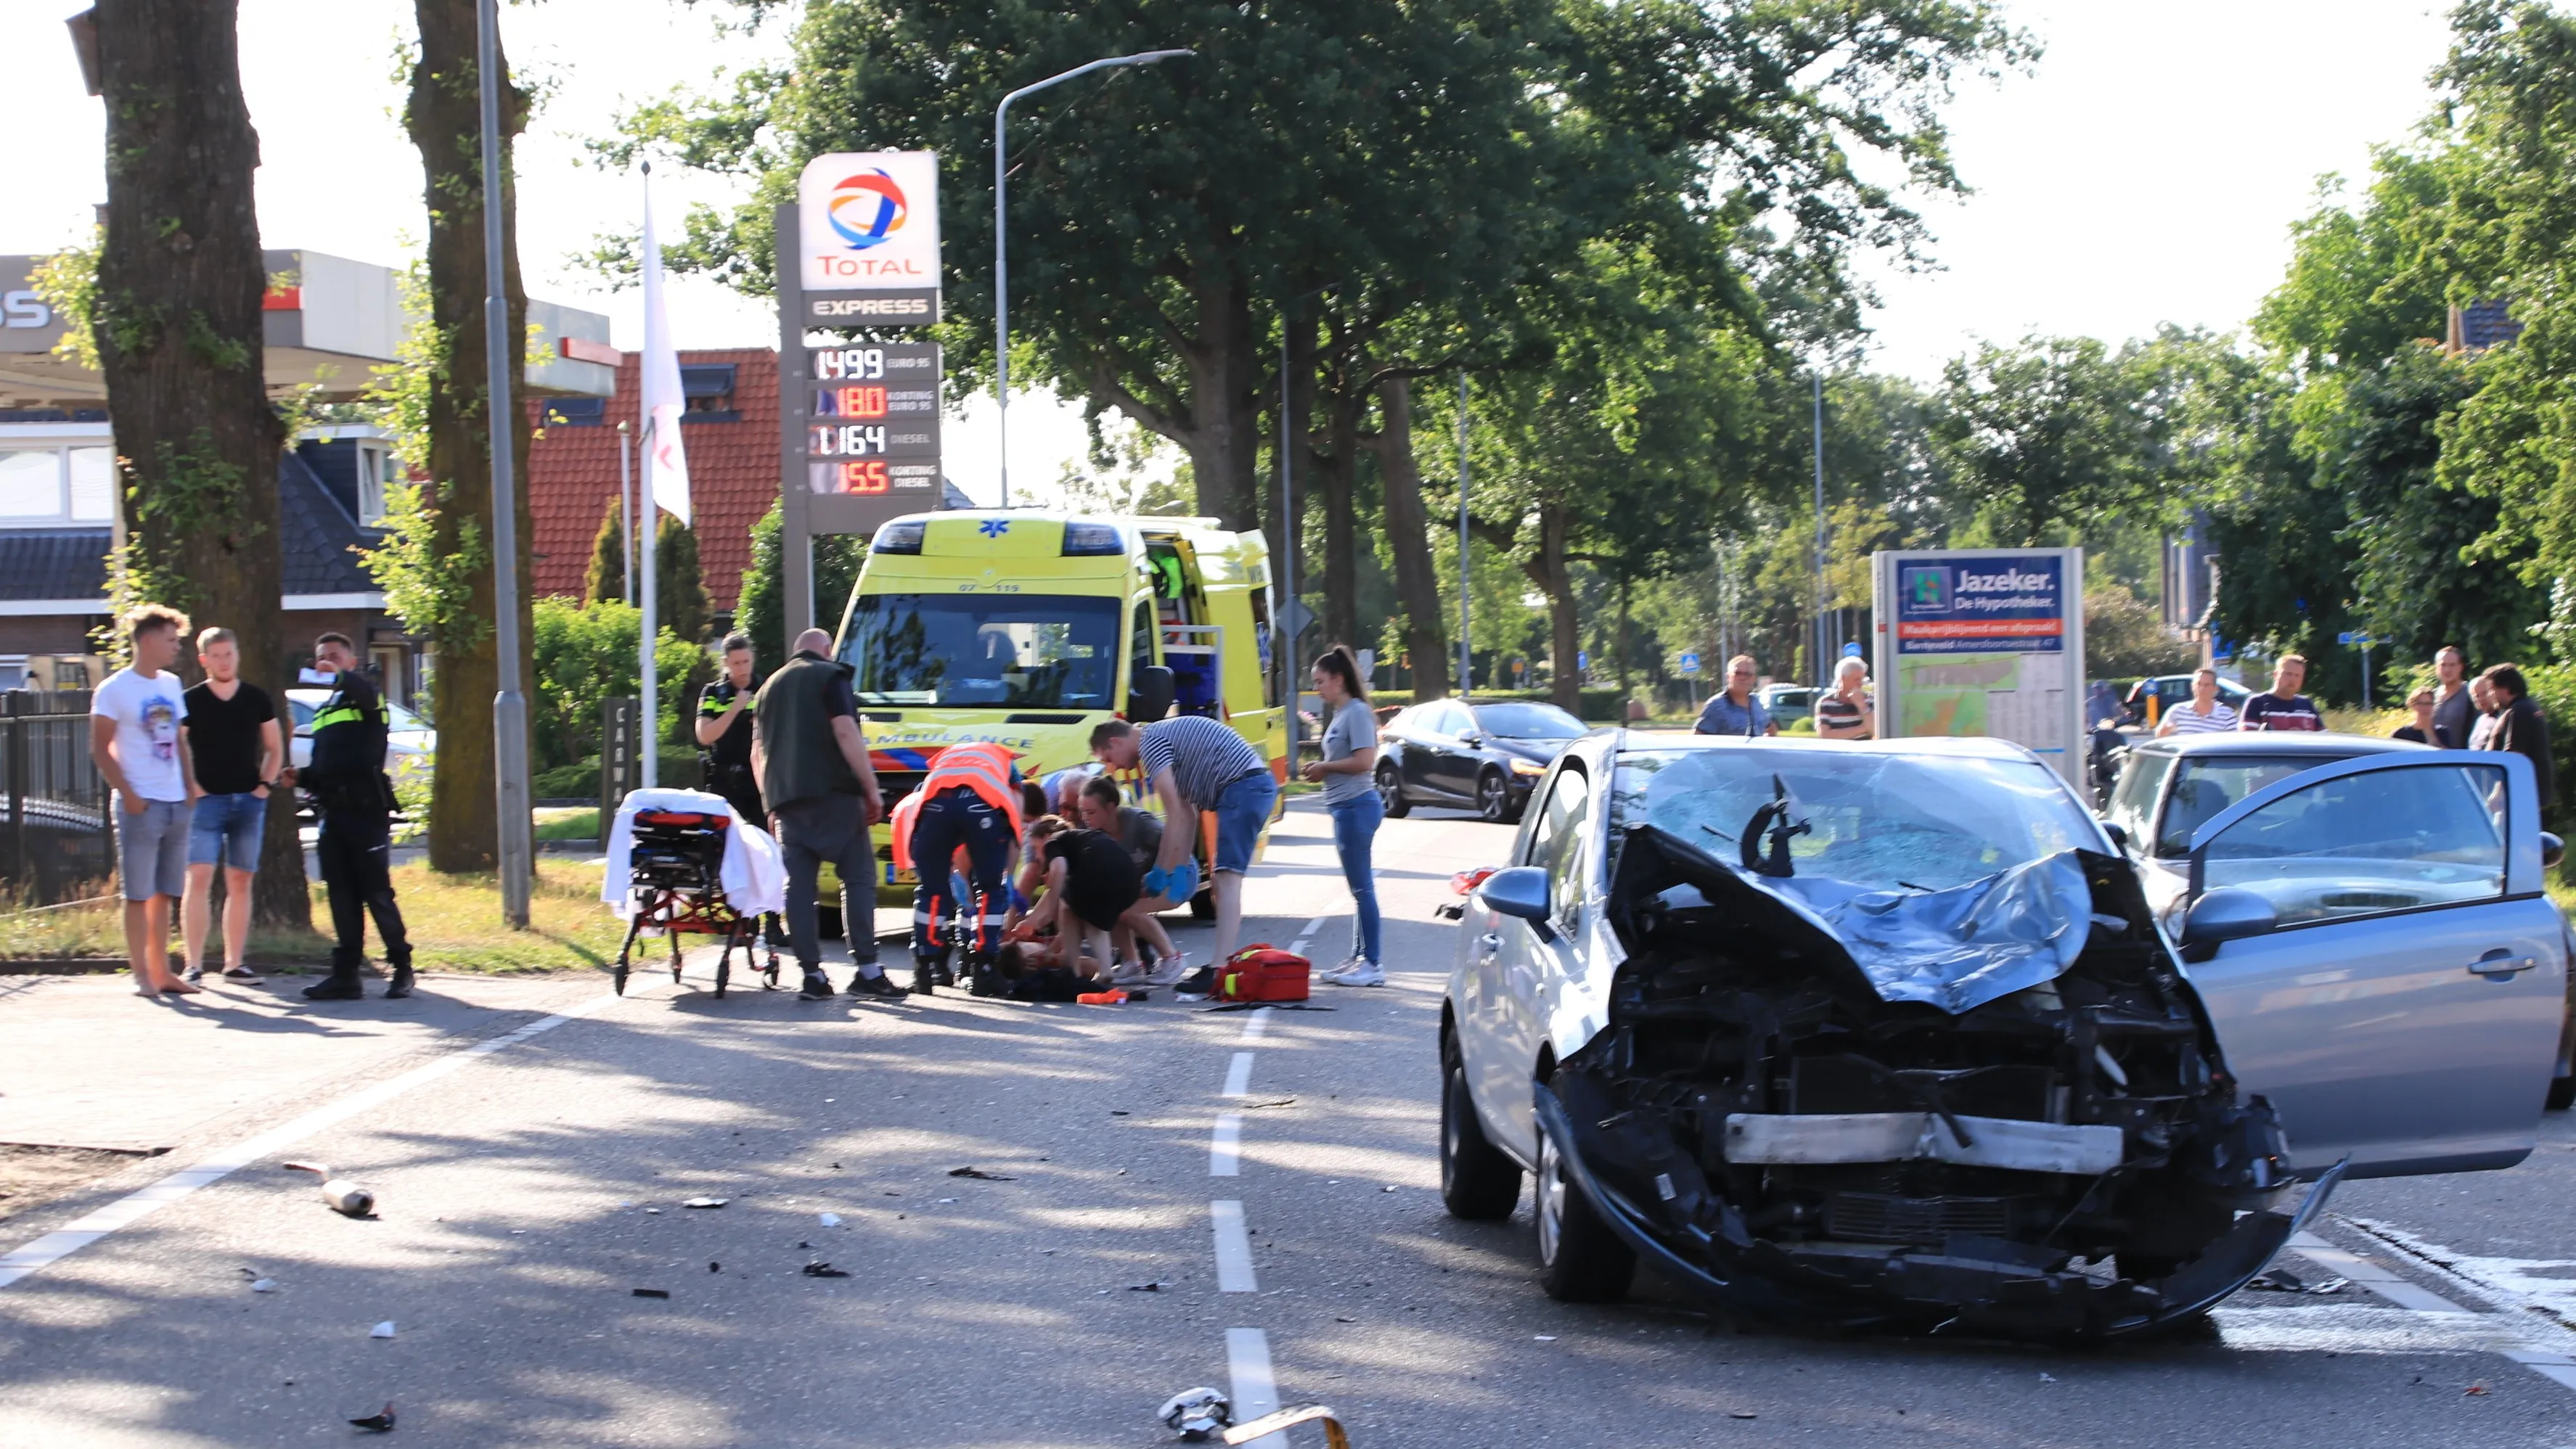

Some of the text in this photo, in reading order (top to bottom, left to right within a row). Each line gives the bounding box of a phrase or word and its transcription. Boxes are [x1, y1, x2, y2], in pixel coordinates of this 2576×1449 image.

[817, 256, 922, 276] TOTAL
[0, 290, 51, 329] S
[812, 299, 929, 316] EXPRESS
[886, 358, 931, 369] EURO 95
[886, 391, 933, 401] KORTING
[888, 401, 932, 411] EURO 95
[890, 434, 931, 444] DIESEL
[888, 465, 936, 476] KORTING
[894, 477, 931, 488] DIESEL
[1955, 567, 2056, 594] Jazeker.
[1954, 597, 1974, 610] De
[1974, 595, 2056, 612] Hypotheker.
[862, 732, 1035, 749] AMBULANCE
[613, 707, 626, 815] CARWA
